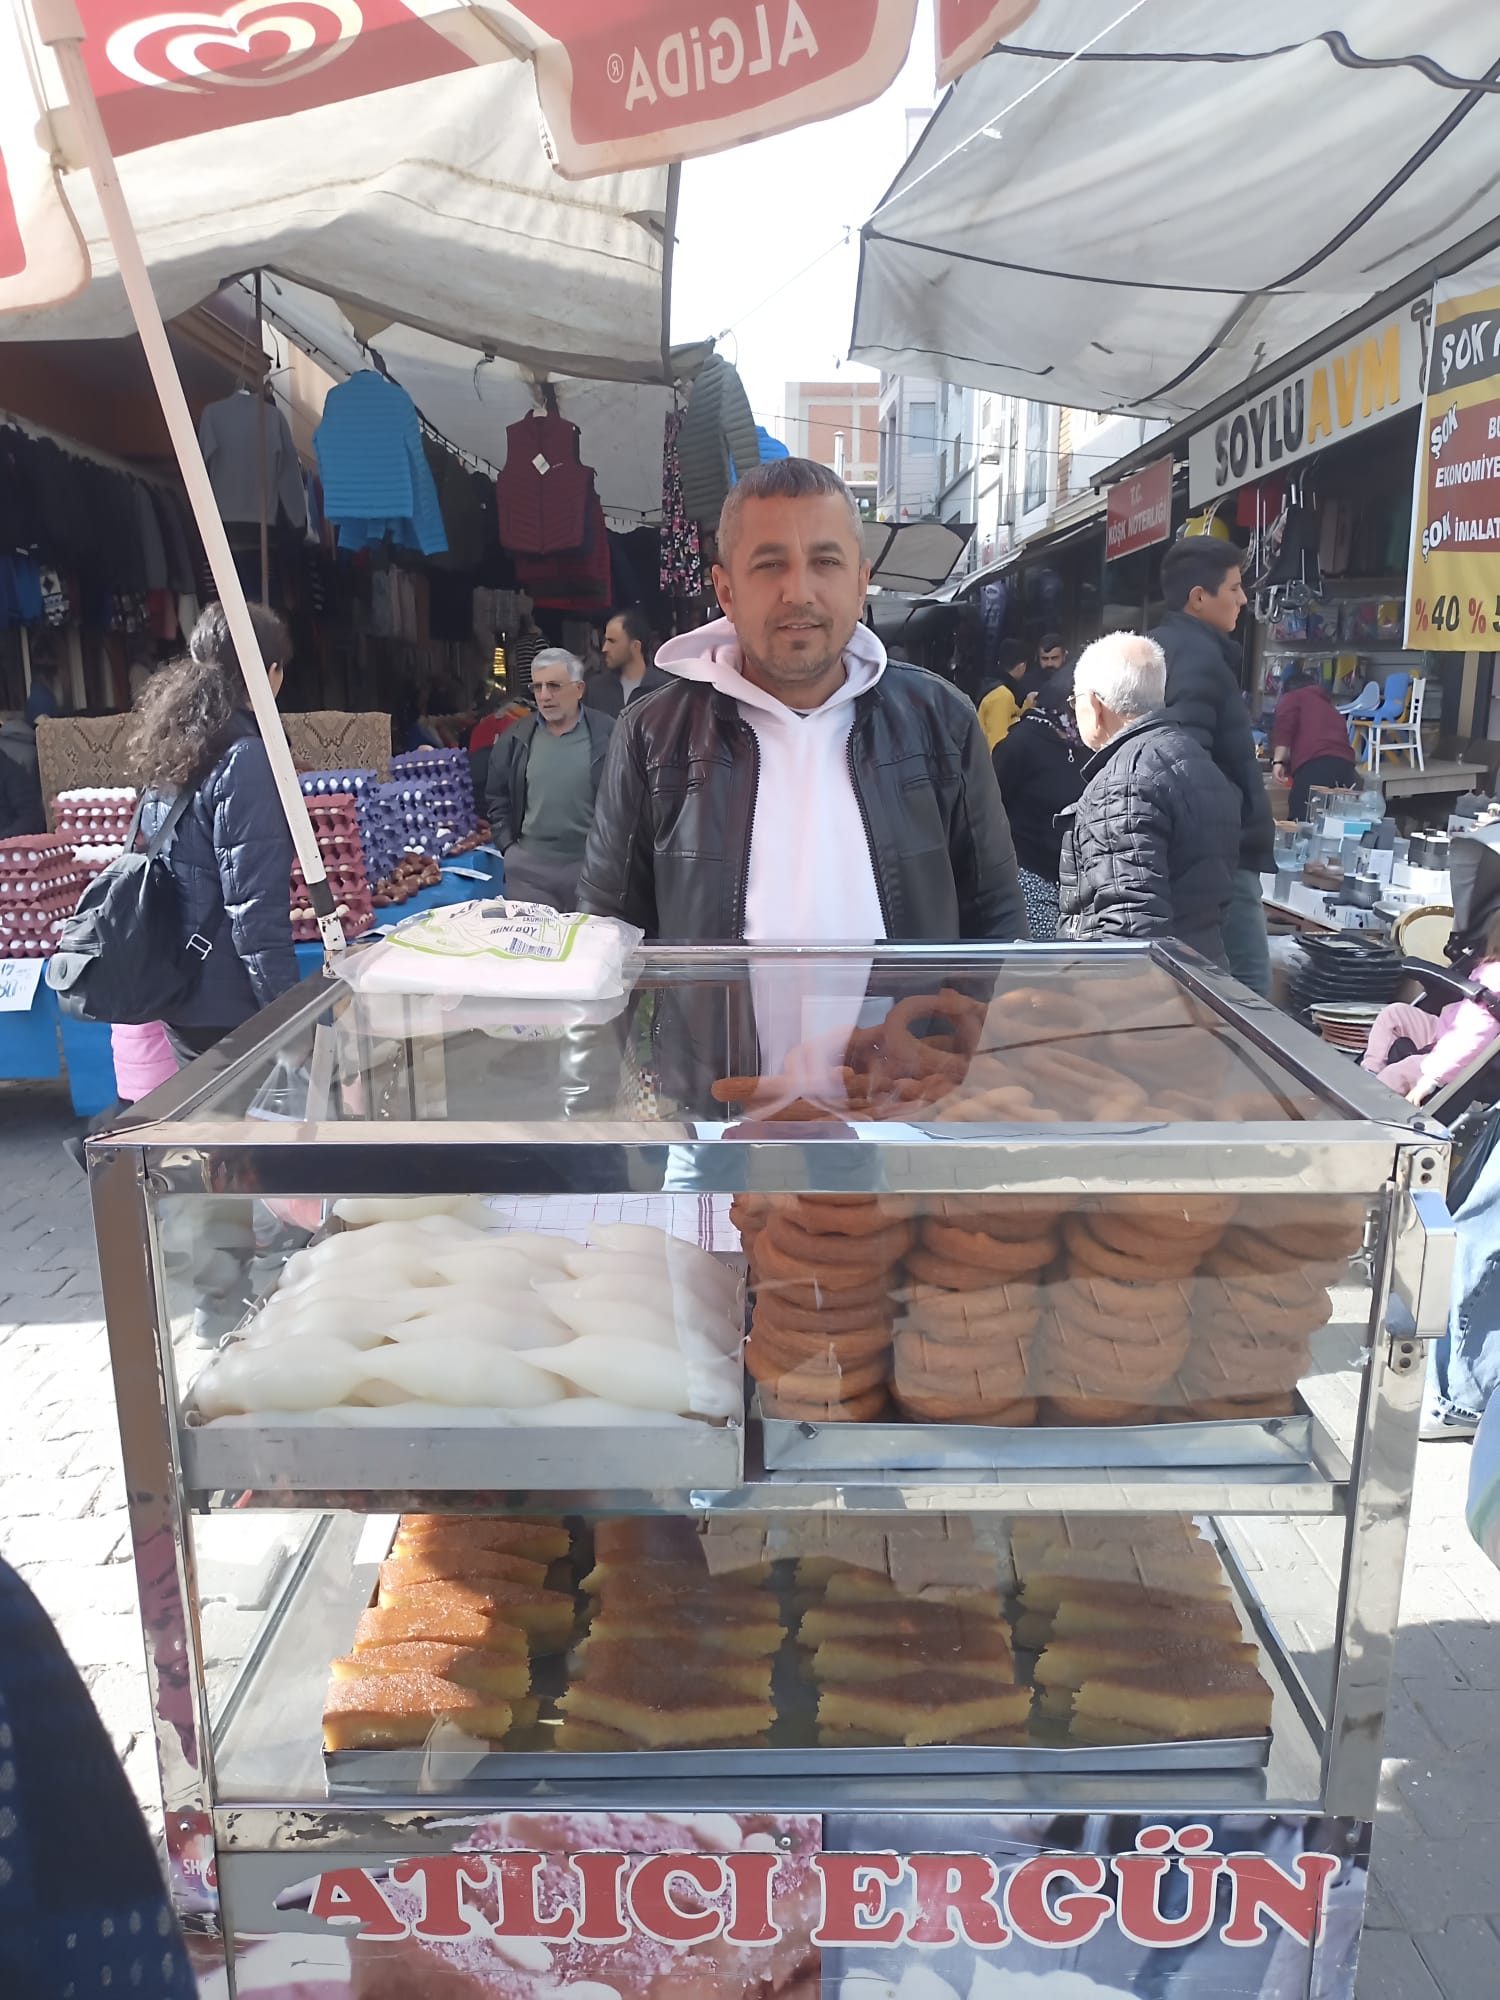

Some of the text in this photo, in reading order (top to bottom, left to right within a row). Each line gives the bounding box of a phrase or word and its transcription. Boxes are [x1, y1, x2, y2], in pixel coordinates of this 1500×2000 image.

[1306, 324, 1400, 444] AVM
[1441, 320, 1491, 385] ŞOK
[1430, 401, 1458, 460] ŞOK
[1422, 512, 1452, 563] ŞOK
[811, 1825, 1341, 1949] ERGÜN
